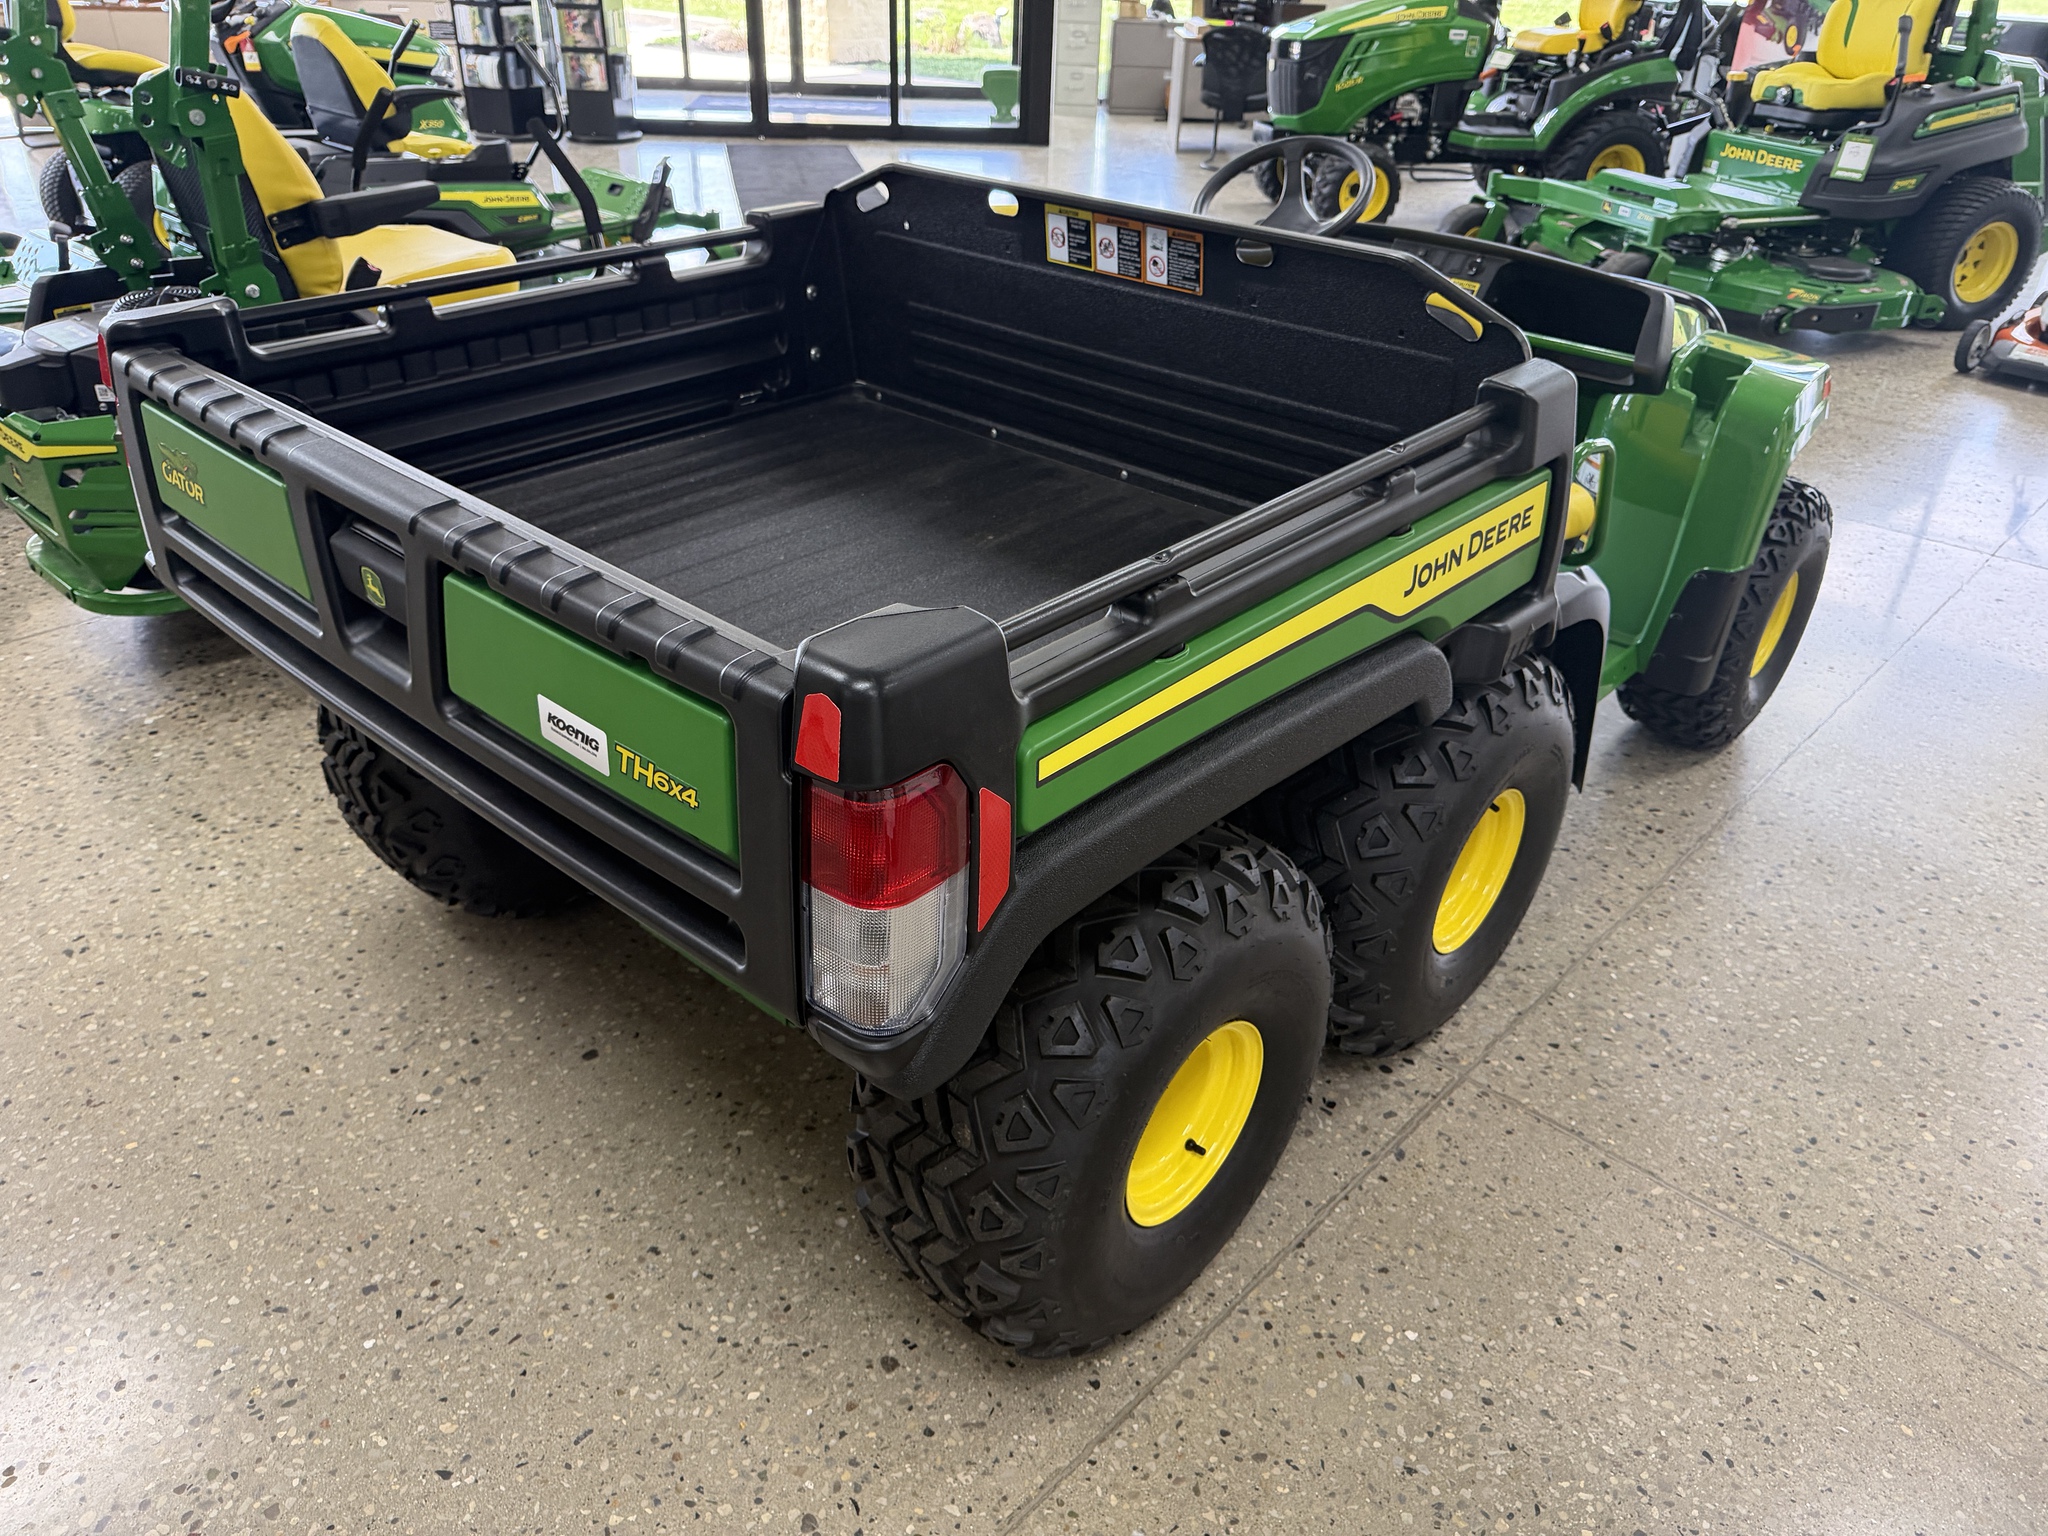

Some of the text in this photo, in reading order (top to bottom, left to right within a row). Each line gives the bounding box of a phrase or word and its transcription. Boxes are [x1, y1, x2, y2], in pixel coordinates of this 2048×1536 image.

[1720, 142, 1804, 172] JOHN DEERE
[162, 461, 205, 505] GATOR
[1403, 505, 1535, 598] JOHN DEERE
